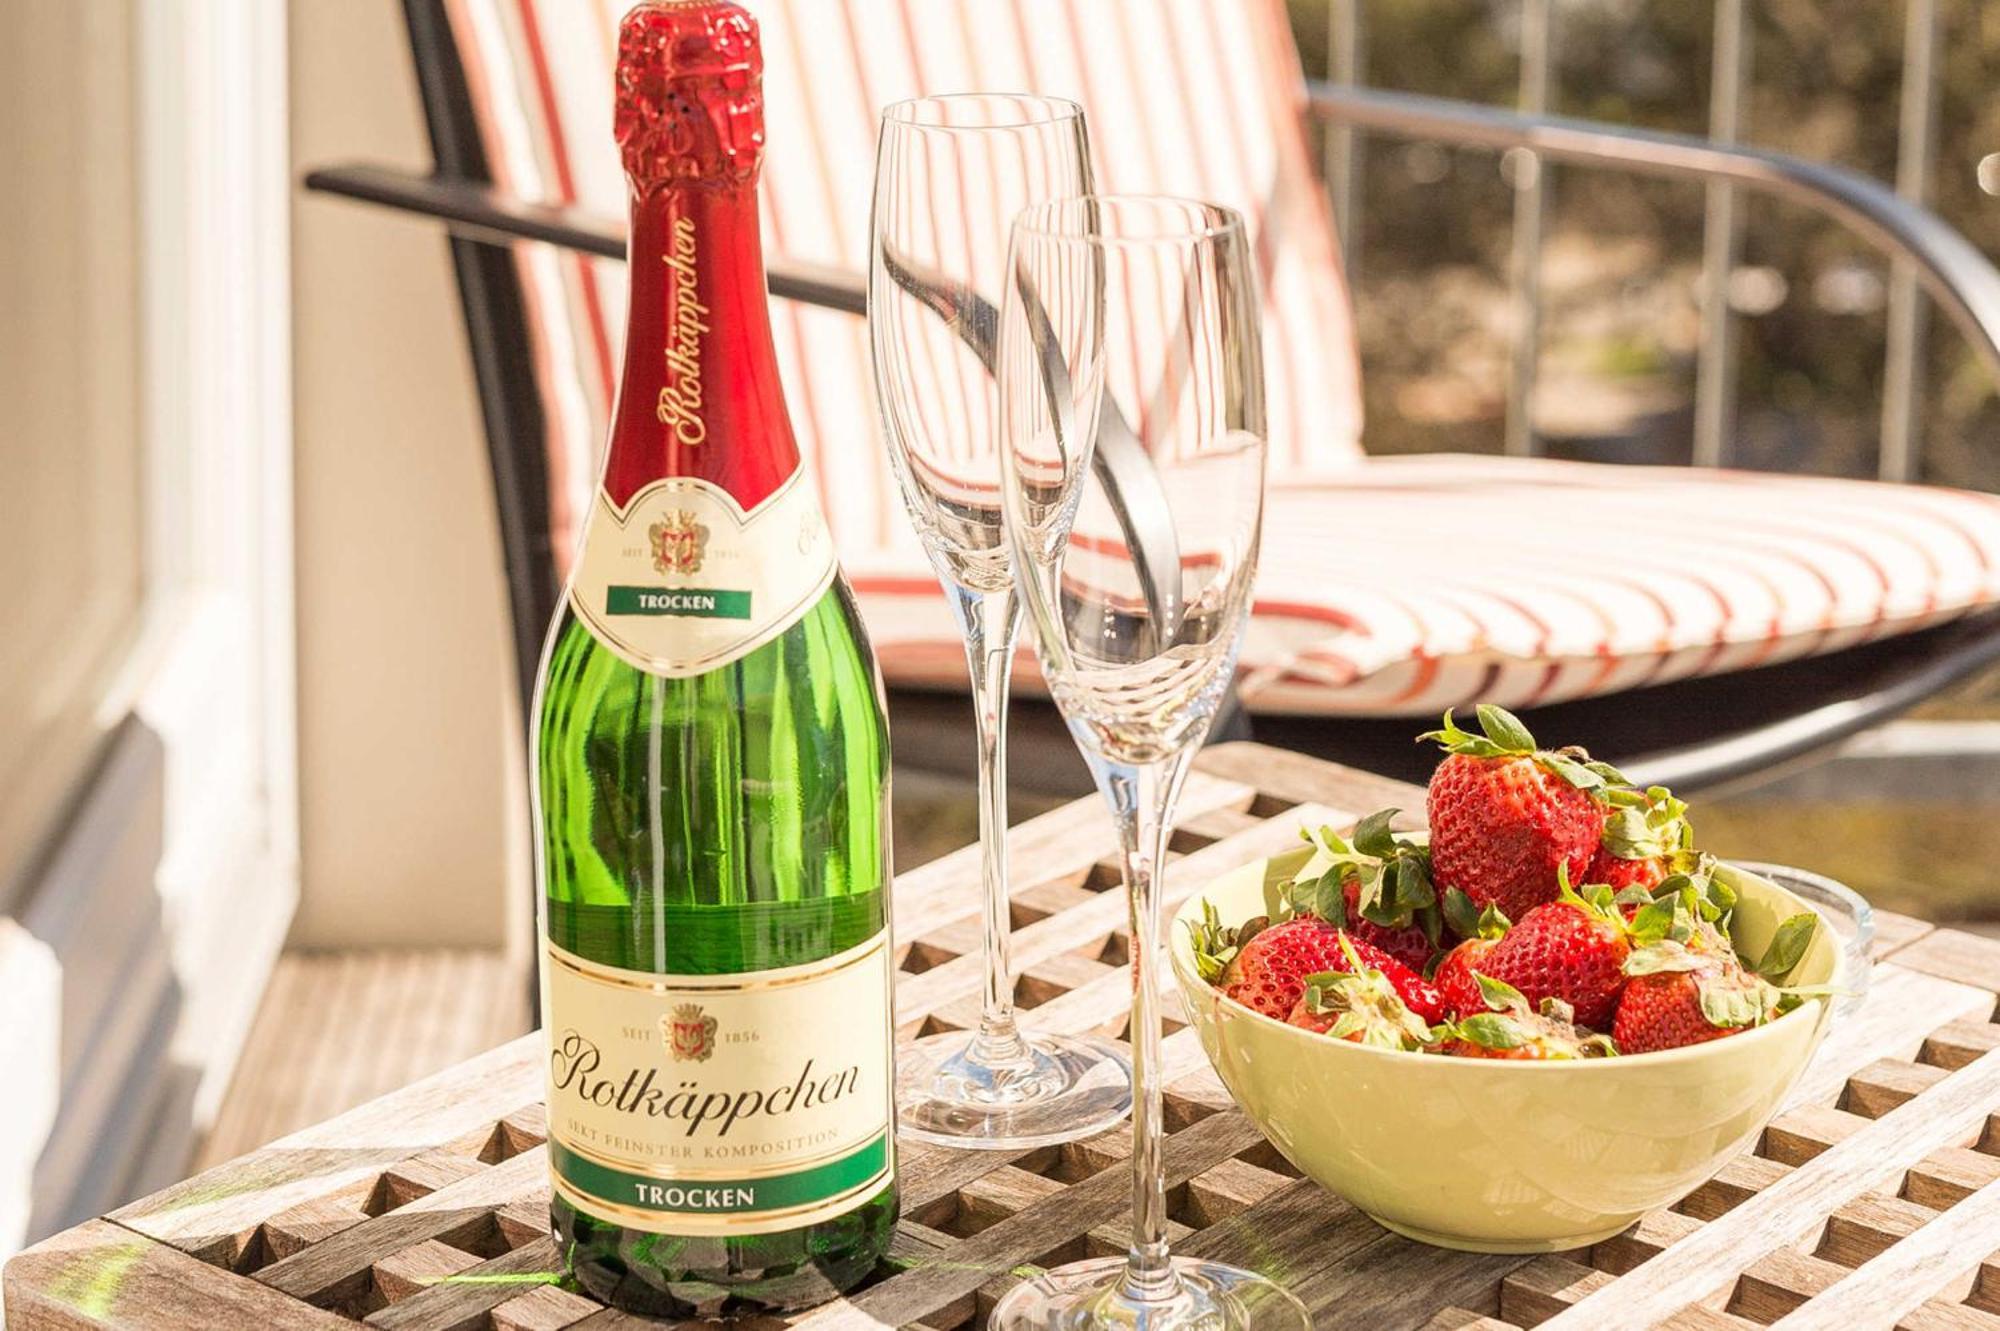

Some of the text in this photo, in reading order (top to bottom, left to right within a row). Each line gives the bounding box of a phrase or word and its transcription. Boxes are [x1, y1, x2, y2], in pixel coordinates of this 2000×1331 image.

[657, 216, 710, 445] Rotkäppchen
[639, 594, 716, 610] TROCKEN
[621, 1026, 760, 1044] SEIT 1856
[551, 1029, 859, 1137] Rotkäppchen
[567, 1118, 839, 1158] SEKT FEINSTER KOMPOSITION
[635, 1183, 755, 1208] TROCKEN
